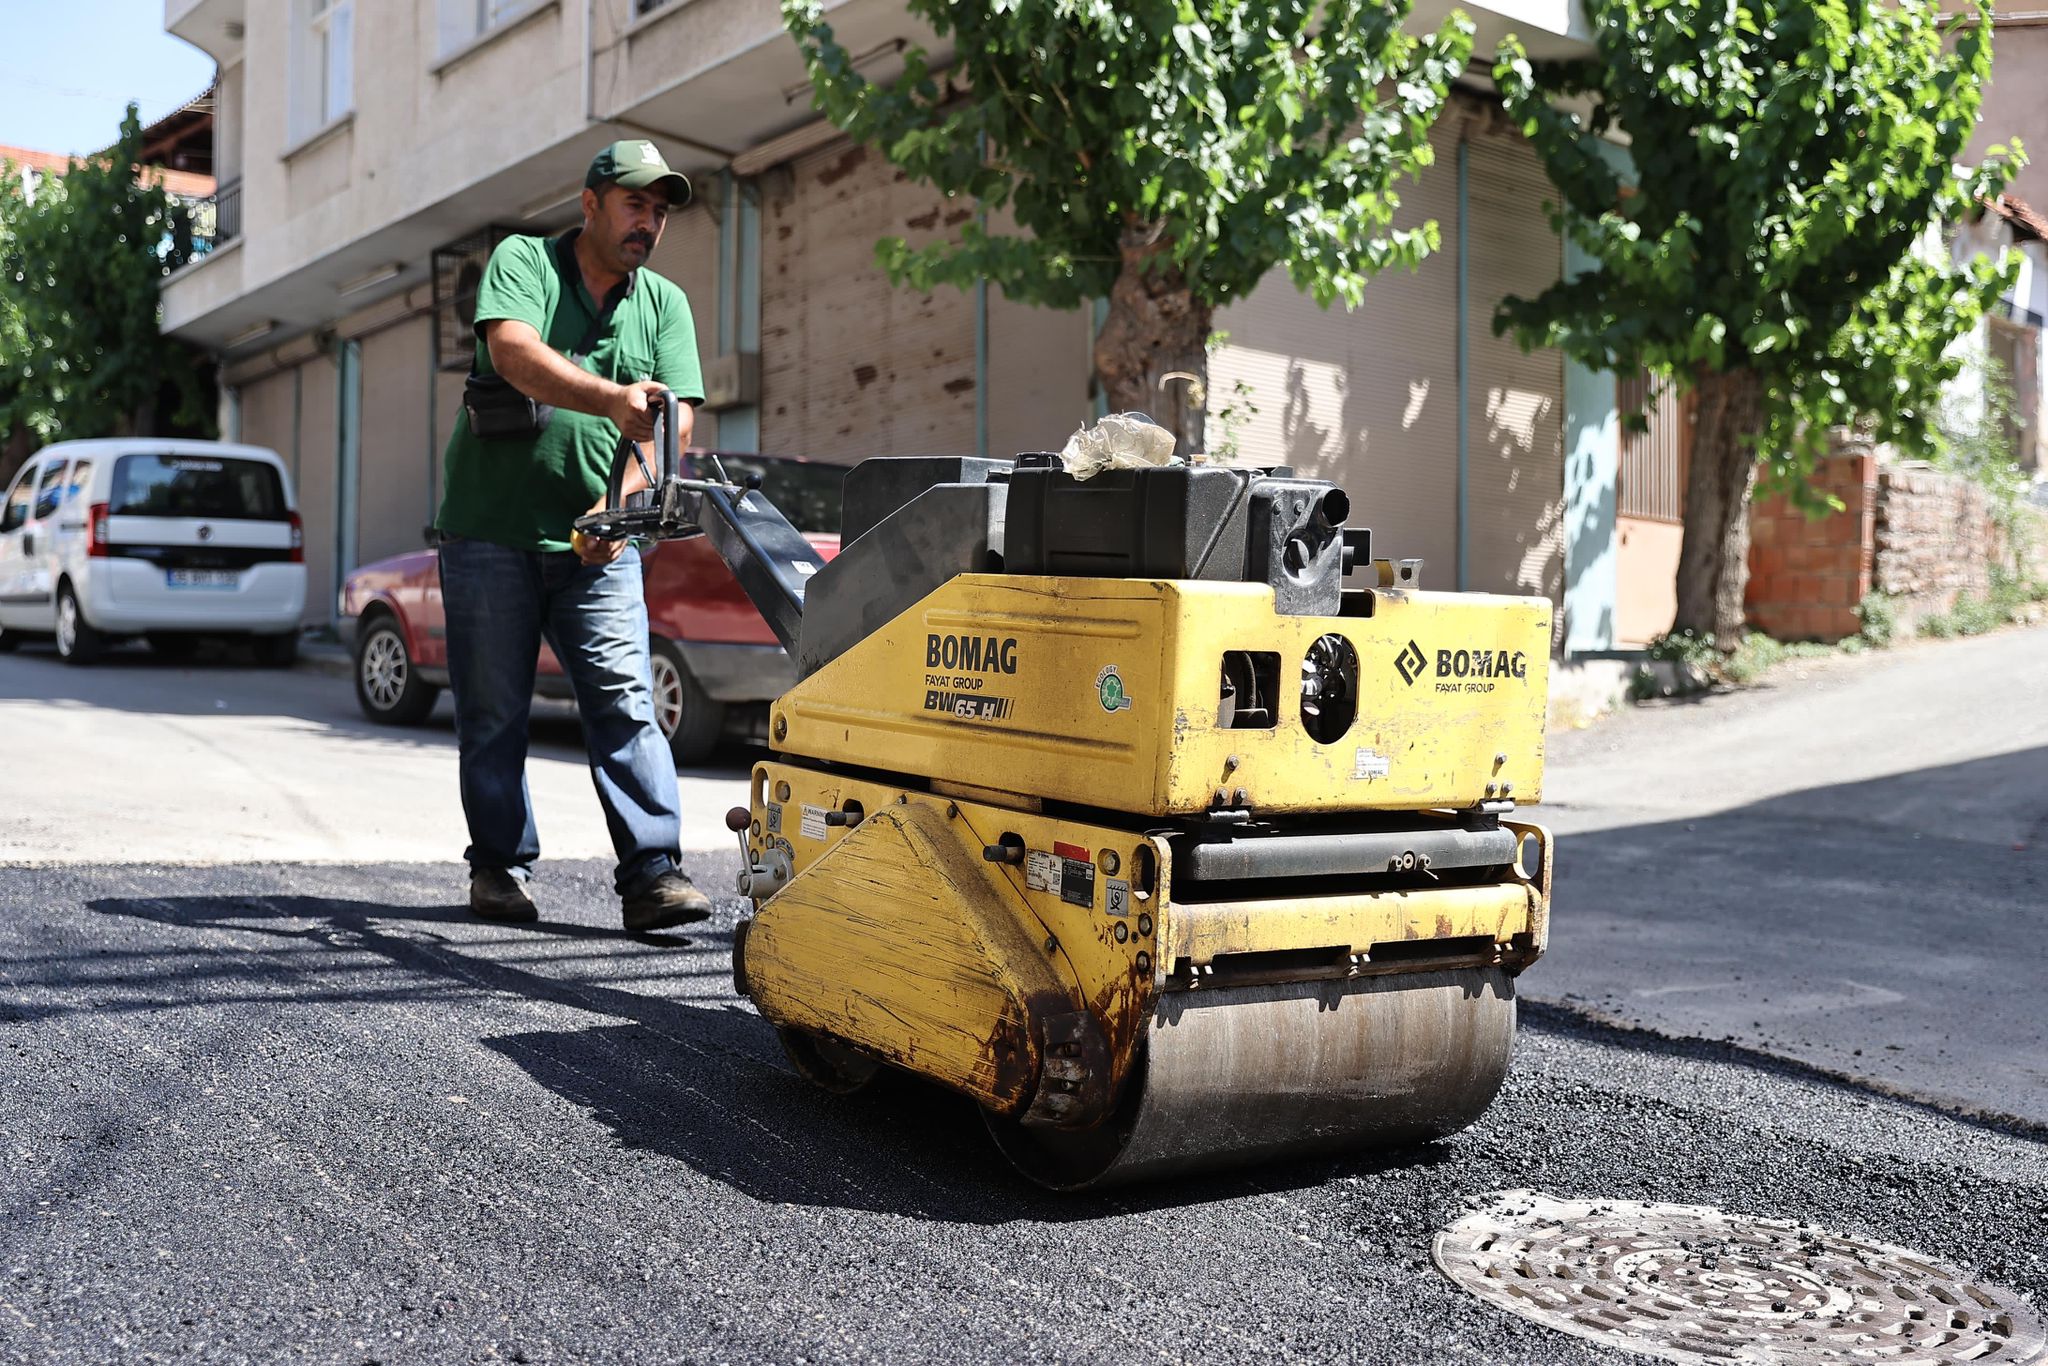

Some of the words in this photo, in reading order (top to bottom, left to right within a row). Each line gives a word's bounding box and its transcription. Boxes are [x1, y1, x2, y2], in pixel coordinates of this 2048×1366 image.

[926, 634, 1017, 674] BOMAG
[1436, 649, 1527, 678] BOMAG
[925, 674, 951, 687] FAYAT
[953, 677, 983, 690] GROUP
[1095, 665, 1117, 688] ECOLOGY
[1435, 683, 1462, 693] FAYAT
[1465, 683, 1495, 693] GROUP
